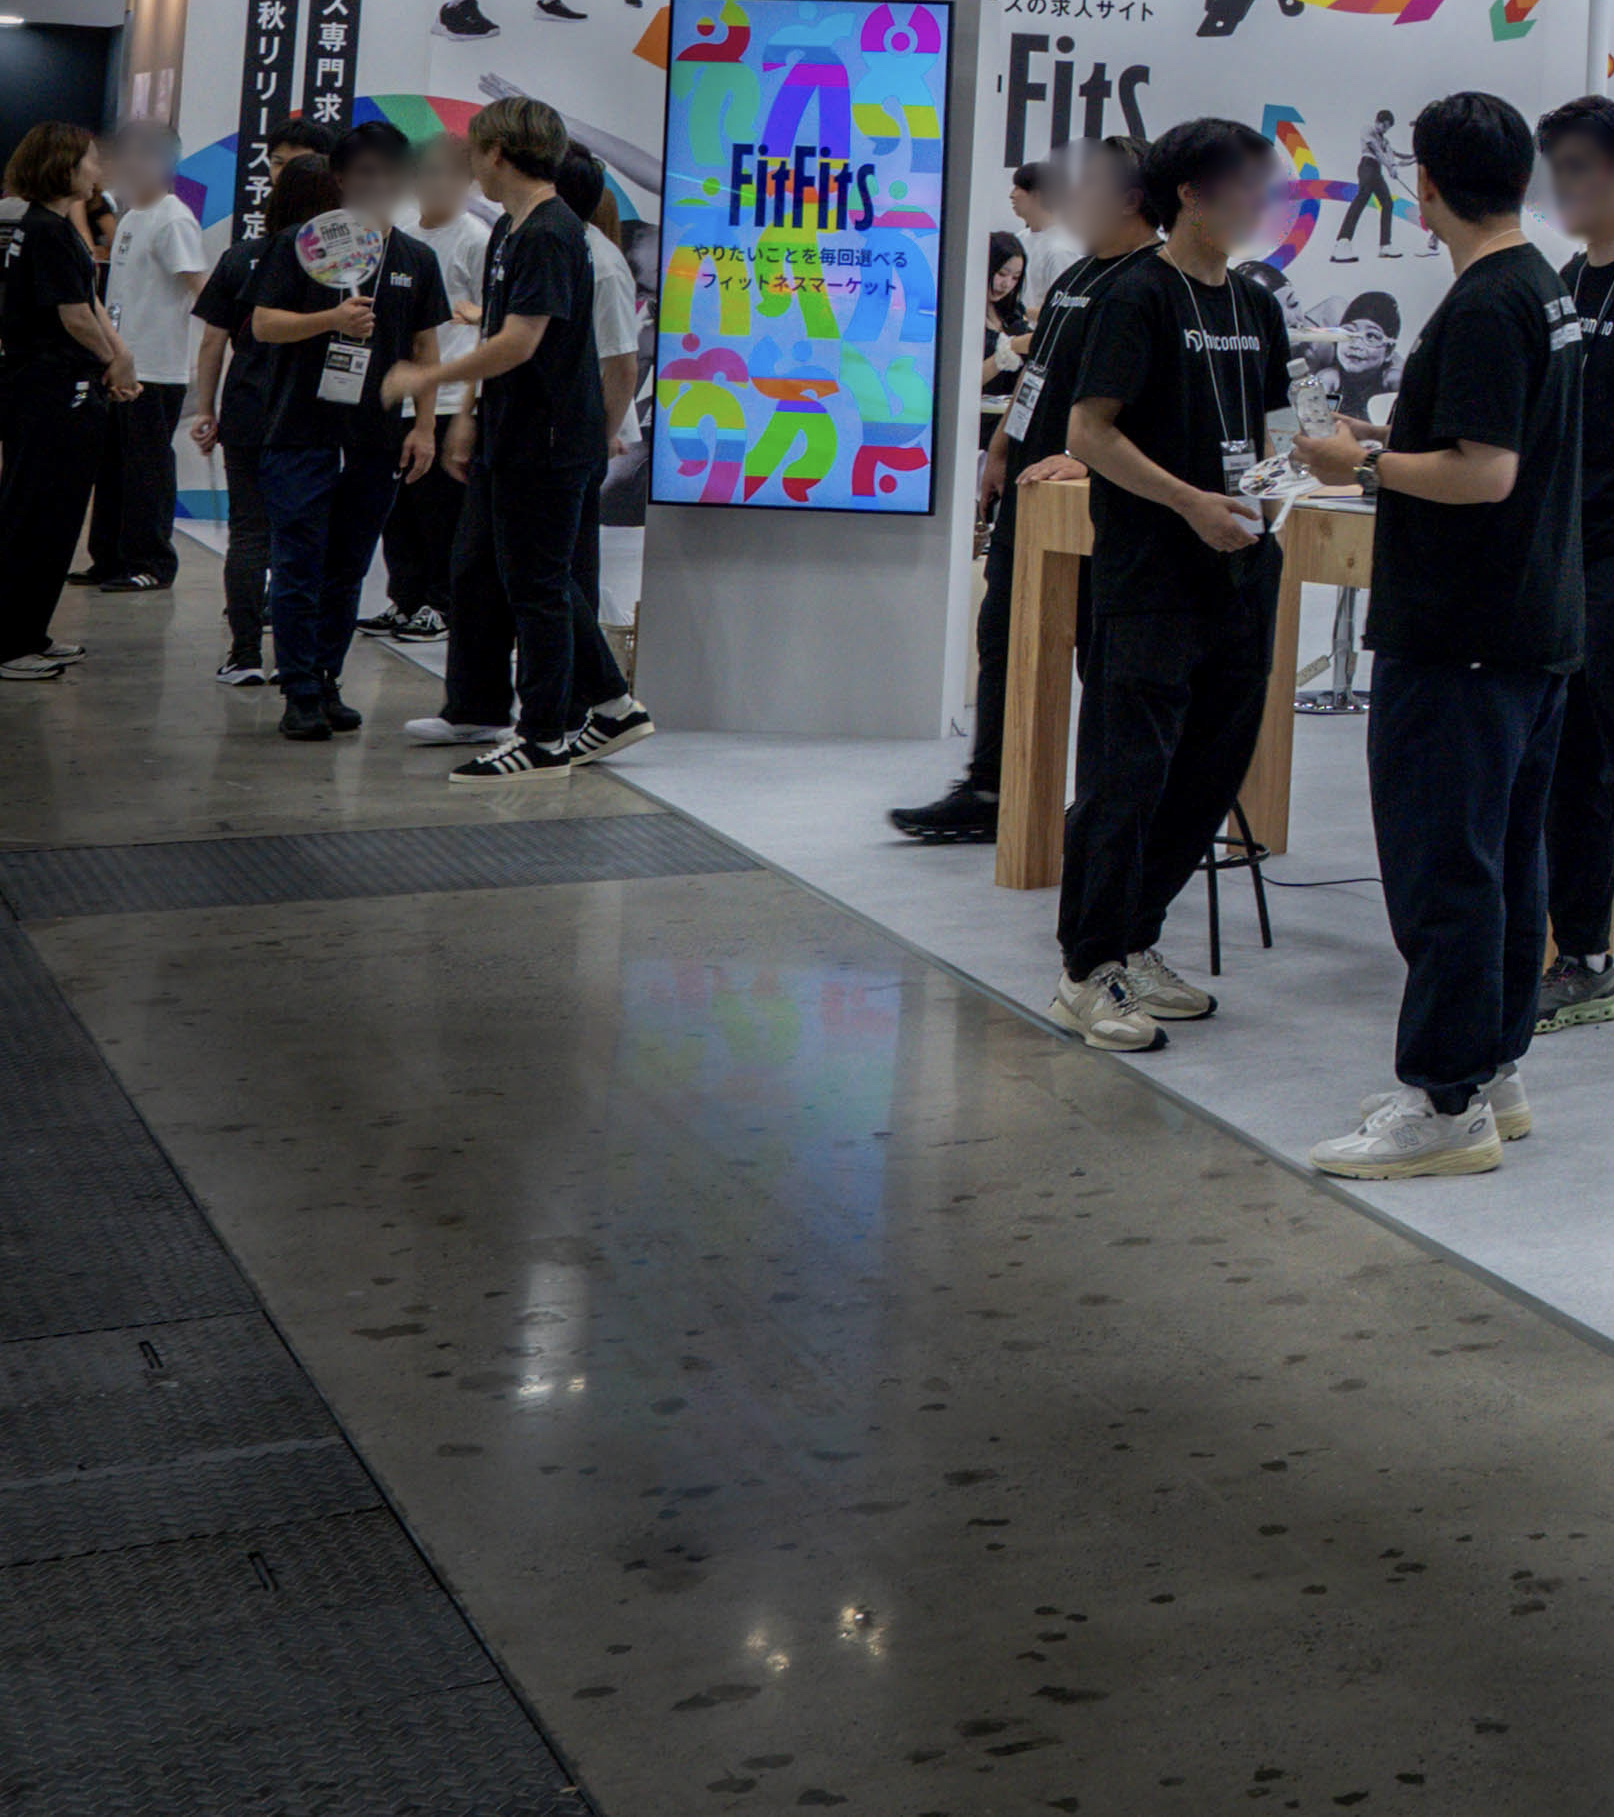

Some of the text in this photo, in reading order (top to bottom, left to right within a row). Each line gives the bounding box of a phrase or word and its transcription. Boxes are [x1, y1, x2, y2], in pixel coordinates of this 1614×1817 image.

[997, 32, 1151, 168] Fits
[728, 143, 876, 232] FitFits
[692, 244, 908, 269] やりたいことを毎回選べる
[701, 273, 898, 295] フィットネスマーケット
